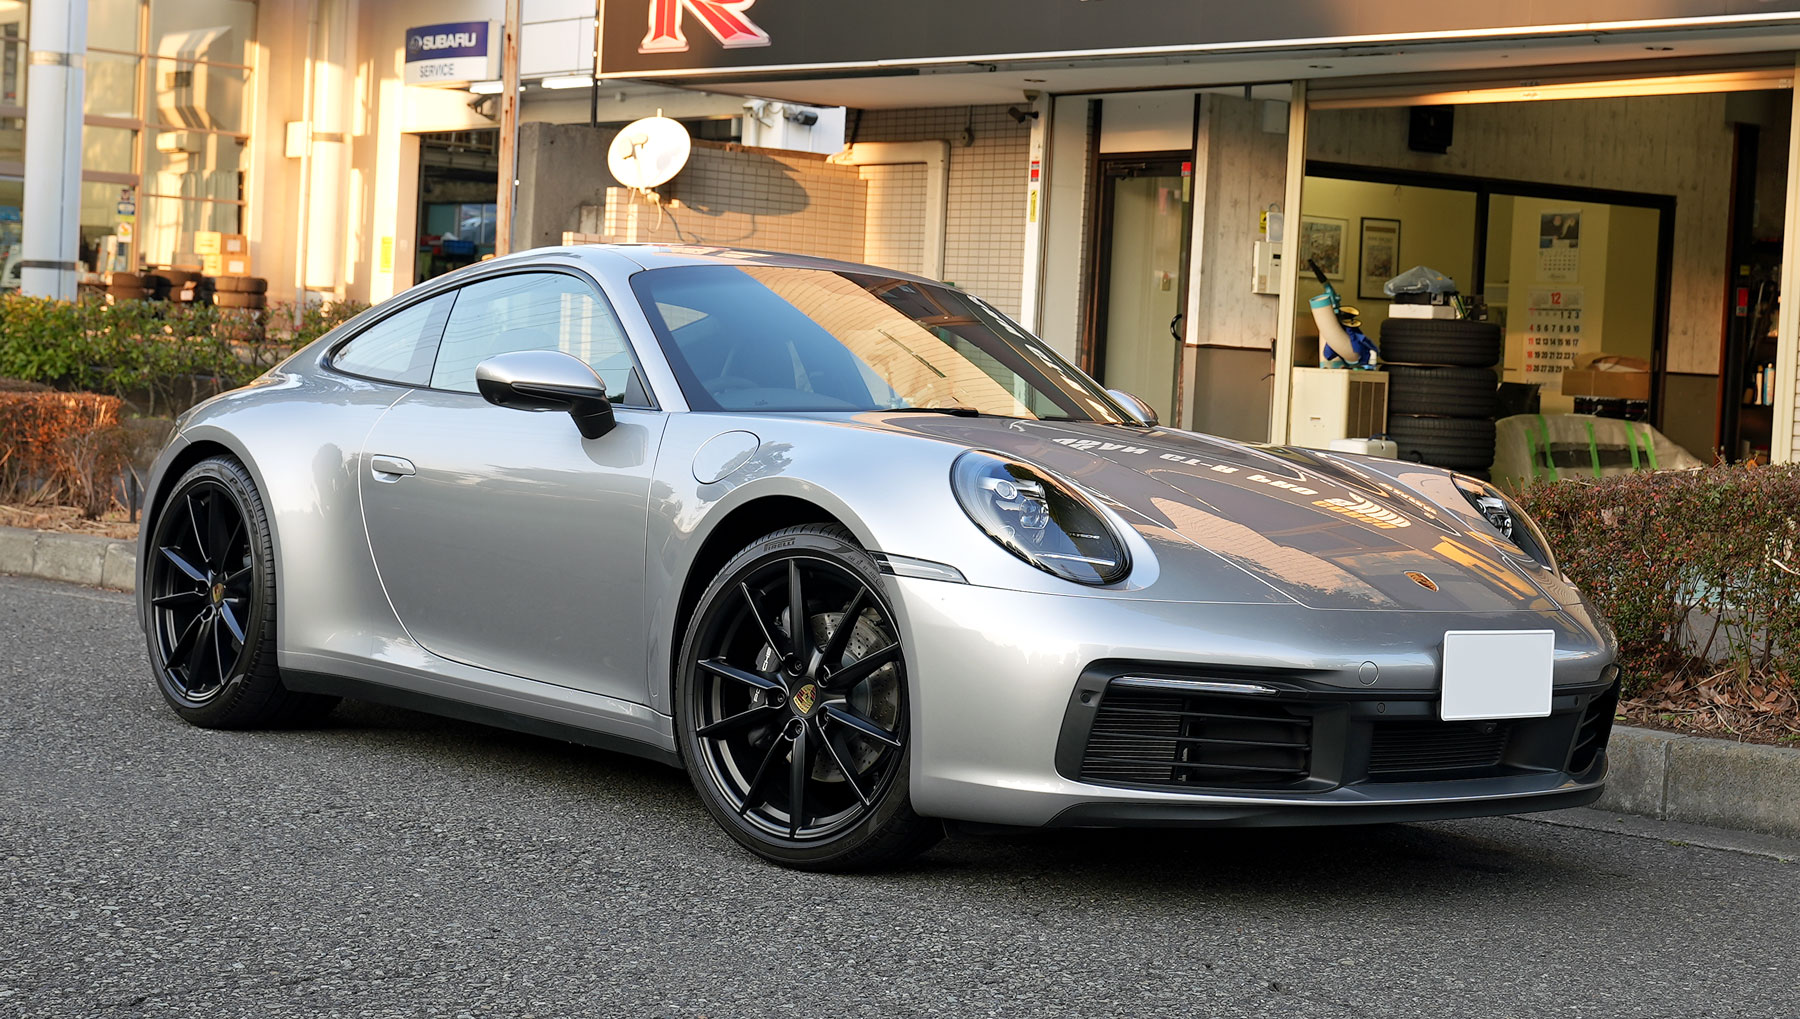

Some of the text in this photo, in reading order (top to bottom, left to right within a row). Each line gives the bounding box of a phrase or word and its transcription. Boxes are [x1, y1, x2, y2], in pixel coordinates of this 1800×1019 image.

[422, 31, 477, 51] SUBARU
[420, 63, 455, 78] SERVICE
[1550, 292, 1561, 305] 12
[1572, 339, 1579, 347] 17
